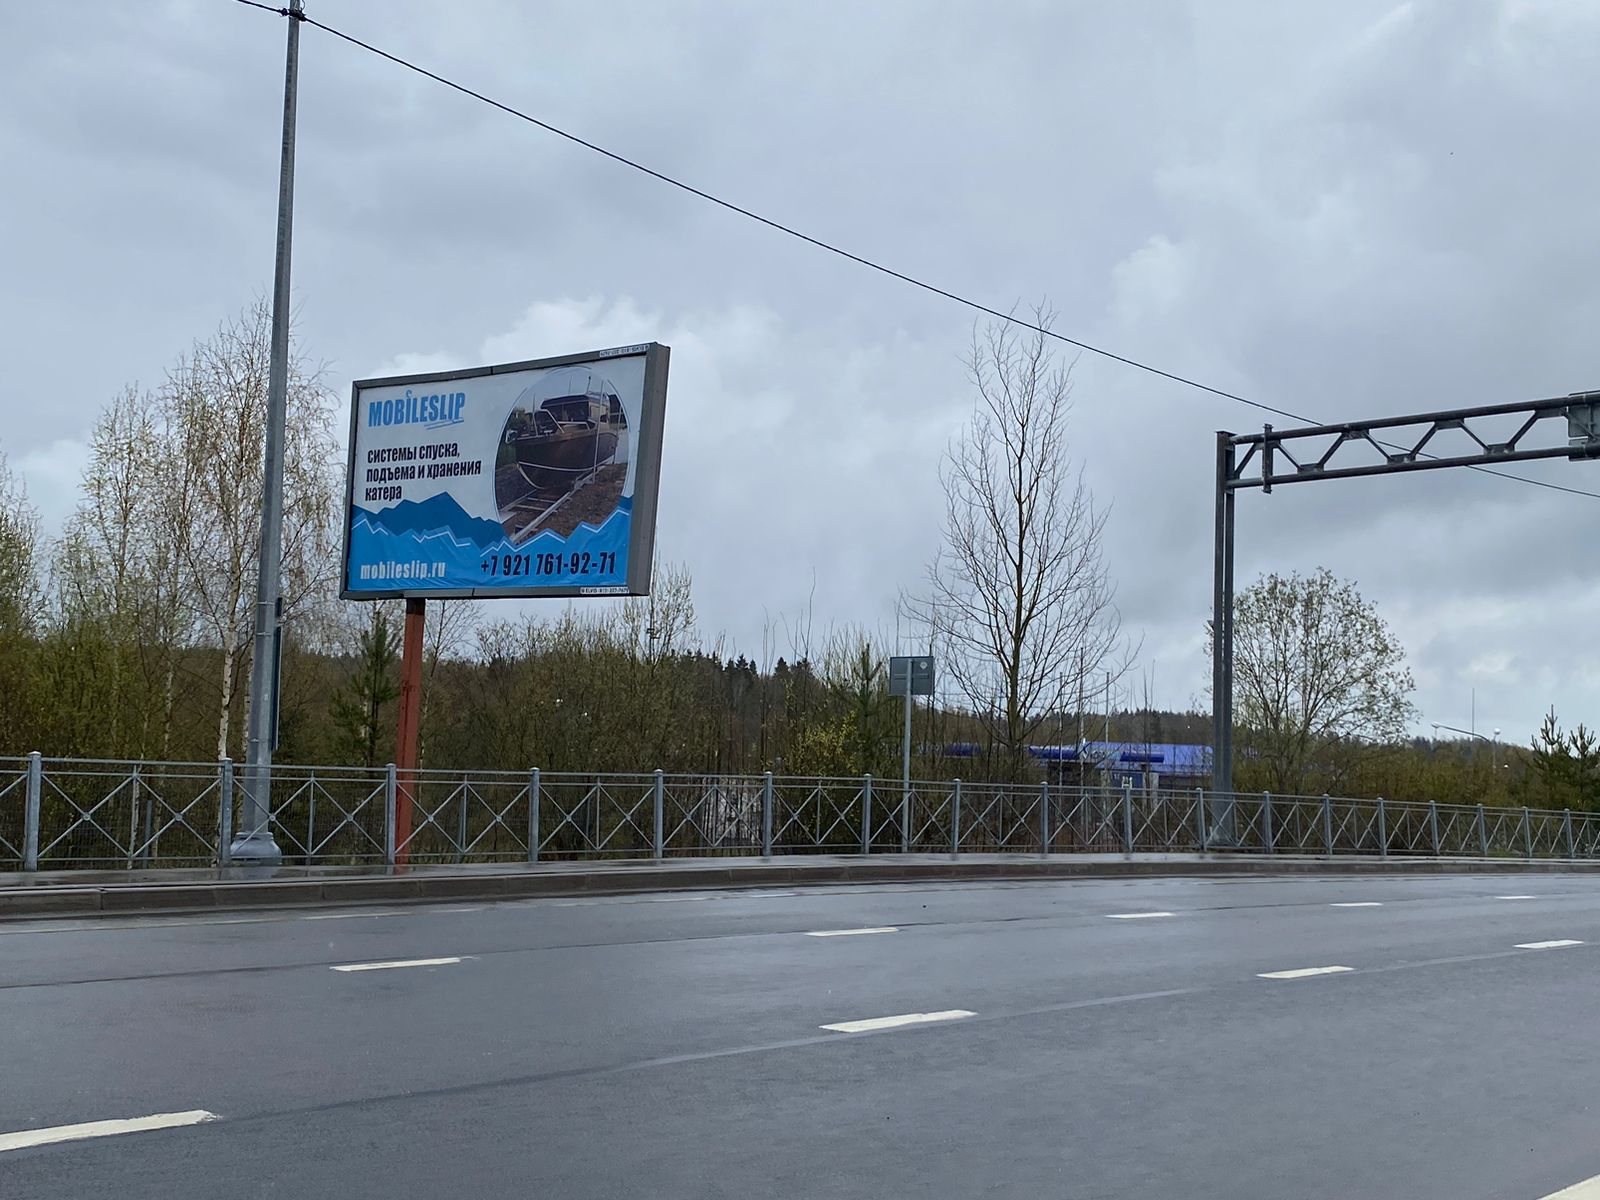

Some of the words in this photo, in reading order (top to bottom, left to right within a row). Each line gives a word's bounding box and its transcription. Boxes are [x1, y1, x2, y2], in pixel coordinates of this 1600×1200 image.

[368, 390, 465, 428] MOBILESLIP
[367, 446, 417, 463] системы
[419, 442, 460, 460] спуска,
[366, 465, 416, 484] подъема
[417, 464, 425, 479] и
[426, 460, 482, 480] хранения
[365, 485, 402, 502] катера
[360, 560, 446, 579] mobileslip.ru
[480, 555, 498, 576] +7
[502, 554, 531, 576] 921
[535, 552, 616, 575] 761-92-71
